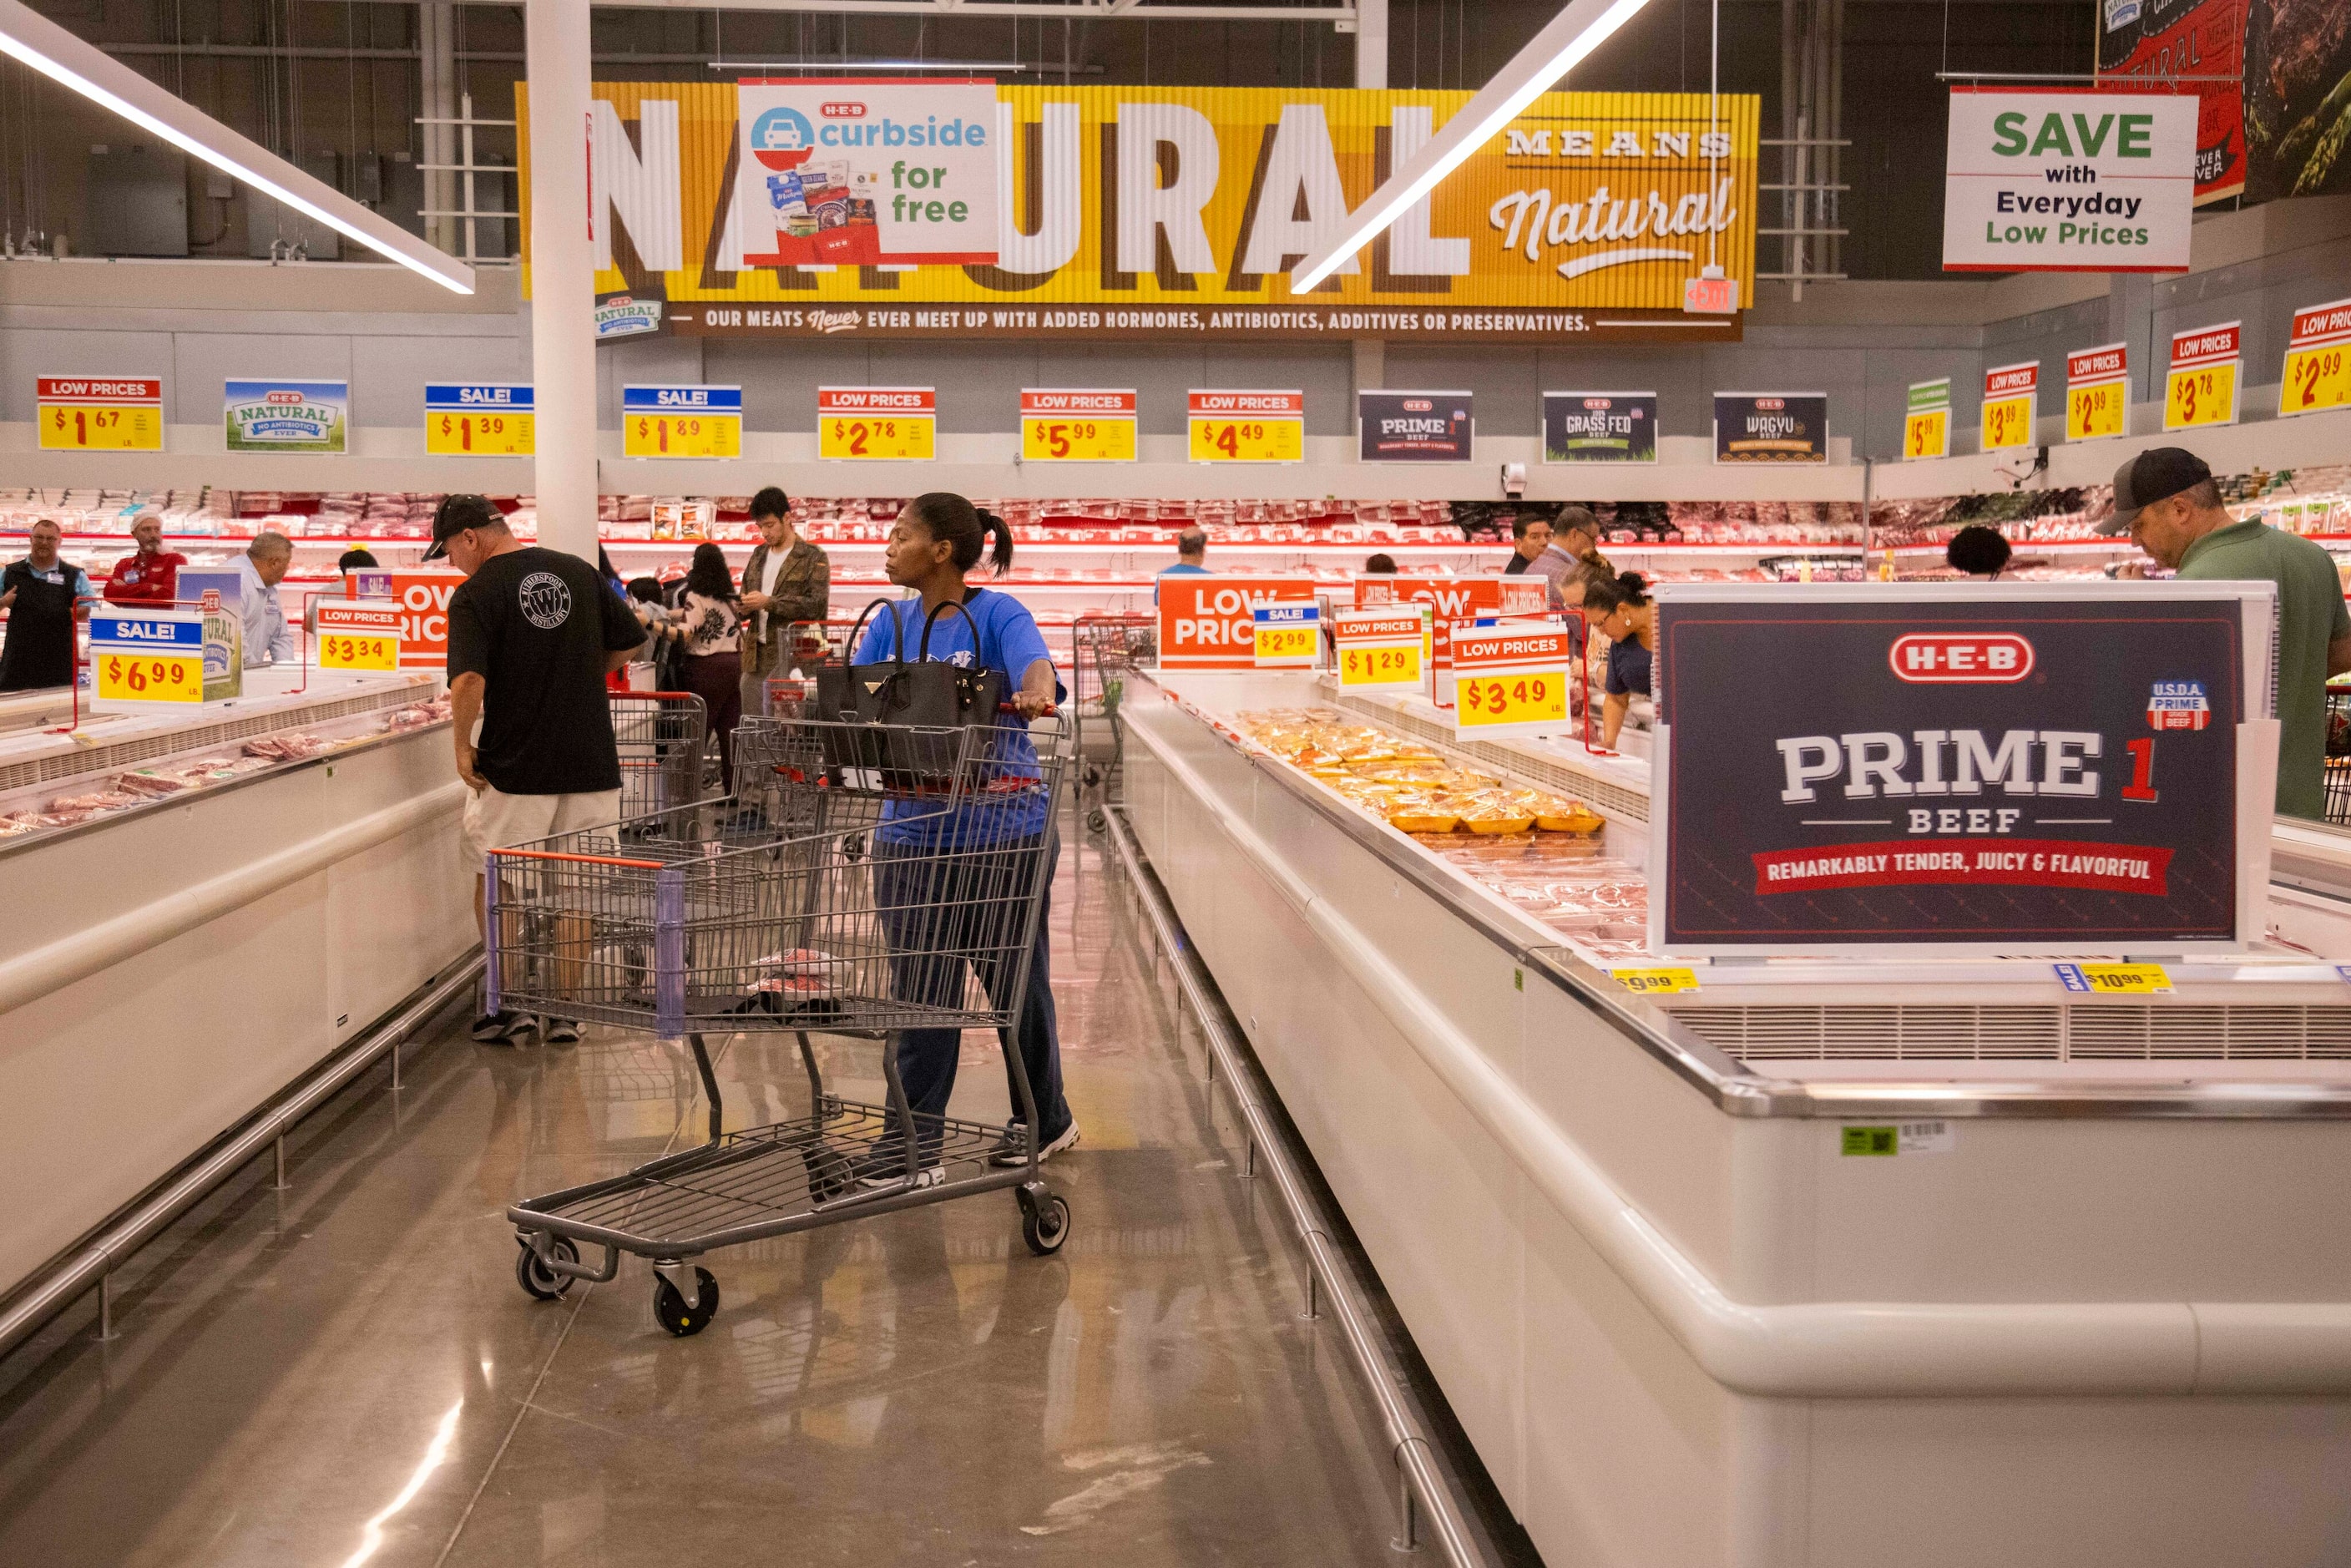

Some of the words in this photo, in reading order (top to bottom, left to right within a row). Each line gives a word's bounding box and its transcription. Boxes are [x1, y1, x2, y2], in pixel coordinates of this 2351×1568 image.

[820, 115, 986, 147] curbside
[1991, 112, 2153, 158] SAVE
[1506, 130, 1731, 157] MEANS
[2196, 149, 2222, 168] EVER
[892, 160, 947, 189] for
[2045, 165, 2096, 183] with
[2196, 164, 2222, 180] VER
[591, 99, 1470, 275] NURAL
[892, 194, 968, 222] free
[1996, 191, 2142, 219] Everyday
[1489, 177, 1737, 262] Natural
[1986, 221, 2048, 244] Low
[2058, 222, 2149, 245] Prices
[705, 311, 742, 327] OUR
[746, 311, 804, 327] MEATS
[806, 310, 862, 331] Never
[867, 311, 910, 327] EVER
[917, 311, 959, 327] MEET
[964, 312, 988, 328] UP
[993, 311, 1037, 327] WITH
[1044, 312, 1100, 327] ADDED
[1105, 312, 1205, 331] HORMONES,
[1211, 312, 1324, 331] ANTIBIOTICS,
[1328, 313, 1418, 330] ADDITIVES
[1423, 314, 1446, 330] OR
[1452, 314, 1590, 331] PRESERVATIVES.
[2302, 314, 2328, 335] LOW
[2328, 310, 2351, 331] PRIC
[2179, 341, 2199, 357] LOW
[2201, 333, 2232, 352] PRICES
[2075, 359, 2092, 375] LOW
[2093, 353, 2120, 370] PRICES
[51, 382, 88, 394] LOW
[91, 383, 147, 396] PRICES
[1991, 376, 2007, 390] LOW
[2008, 371, 2032, 387] PRICES
[460, 388, 511, 403] SALE!
[657, 391, 708, 406] SALE!
[832, 394, 866, 406] LOW
[870, 394, 922, 407] PRICES
[1034, 396, 1068, 407] LOW
[1071, 397, 1123, 408] PRICES
[1201, 397, 1236, 408] LOW
[1239, 397, 1289, 409] PRICES
[240, 406, 328, 422] NATURAL
[271, 422, 316, 432] ANTIBIOTICS
[1381, 419, 1445, 434] PRIME
[1566, 416, 1606, 433] GRASS
[1608, 416, 1631, 434] FED
[1747, 417, 1794, 433] WAGYU
[397, 584, 456, 612] OW
[1196, 589, 1278, 616] LOW
[325, 611, 352, 621] LOW
[354, 613, 394, 623] PRICES
[1268, 609, 1304, 620] SALE!
[117, 622, 175, 640] SALE!
[1176, 619, 1255, 645] PRIC
[1342, 624, 1371, 634] LOW
[1373, 621, 1414, 632] PRICES
[1463, 642, 1500, 657] LOW
[1503, 639, 1559, 655] PRICES
[1906, 646, 2017, 670] H-E-B
[2153, 683, 2203, 696] U.S.D.A.
[2155, 699, 2200, 710] PRIME
[2166, 717, 2192, 727] BEEF
[1776, 730, 2103, 804] PRIME
[2121, 736, 2159, 804] 1
[1908, 808, 2020, 834] BEEF
[1767, 853, 1888, 882] REMARKABLY
[1893, 852, 1970, 873] TENDER,
[1975, 852, 2028, 872] JUICY
[2032, 852, 2045, 872] &
[2050, 853, 2151, 880] FLAVORFUL
